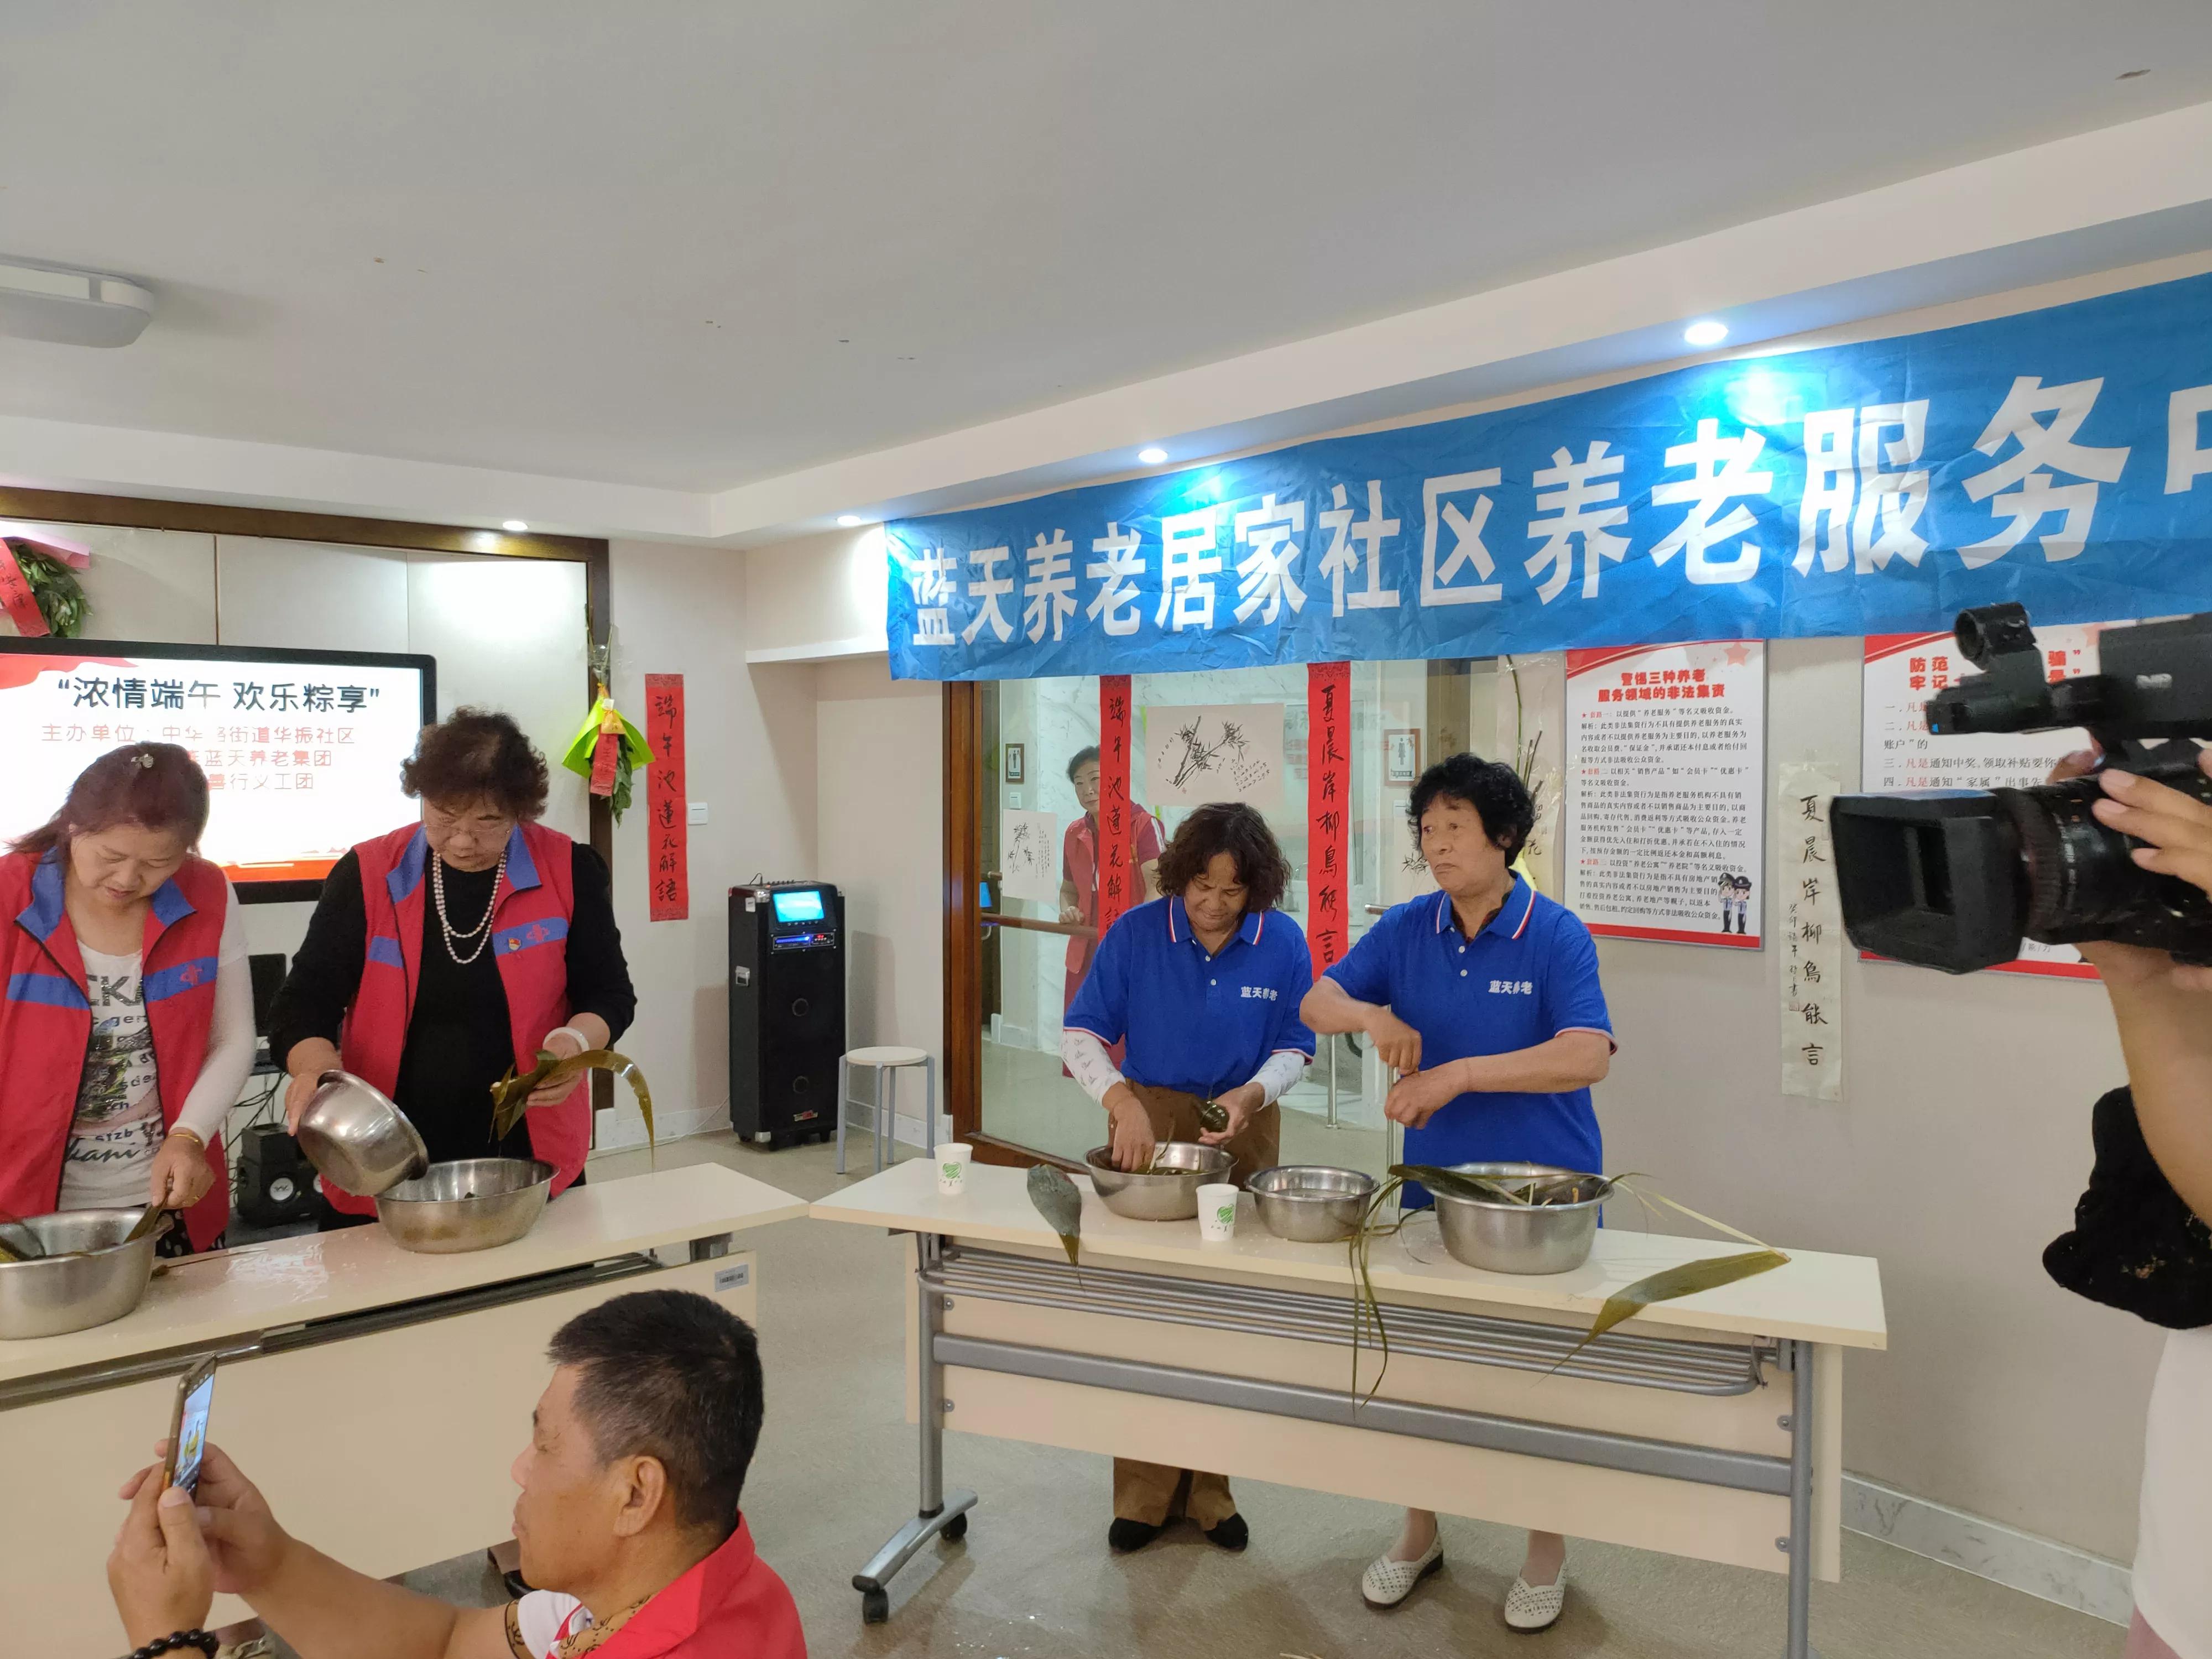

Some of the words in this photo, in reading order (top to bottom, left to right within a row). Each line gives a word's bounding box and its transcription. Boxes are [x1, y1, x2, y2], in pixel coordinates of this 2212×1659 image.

[1910, 656, 1948, 672] 防范
[1620, 668, 1705, 686] 警惕三种养老
[1910, 675, 1948, 691] 牢记
[58, 677, 221, 709] “浓情端午
[232, 681, 380, 713] 欢乐粽享”
[1598, 683, 1725, 702] 服务领域的非法集资
